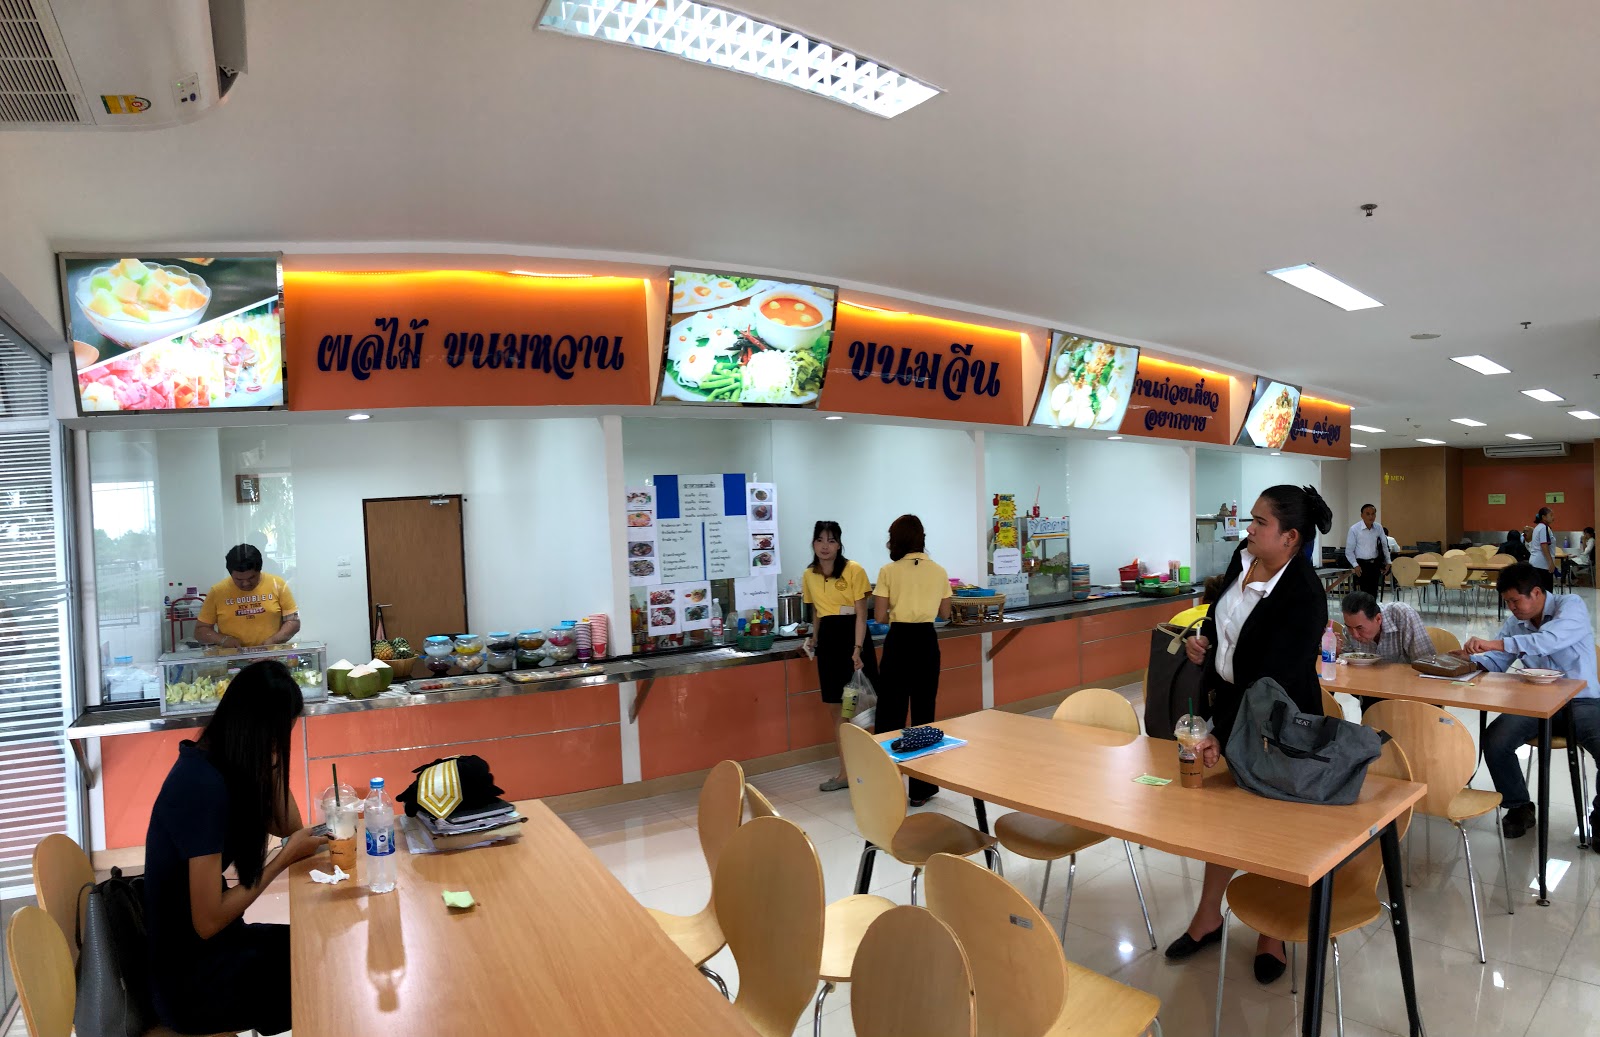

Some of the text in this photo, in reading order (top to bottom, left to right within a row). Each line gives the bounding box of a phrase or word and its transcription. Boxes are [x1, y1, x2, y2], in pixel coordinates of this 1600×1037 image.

[317, 317, 625, 380] ผลไม้ ขนมหวาน
[848, 341, 1001, 401] ขนมจีน
[1130, 371, 1219, 413] านก๋วยเตี๋ยว
[236, 594, 266, 604] DOUBLE
